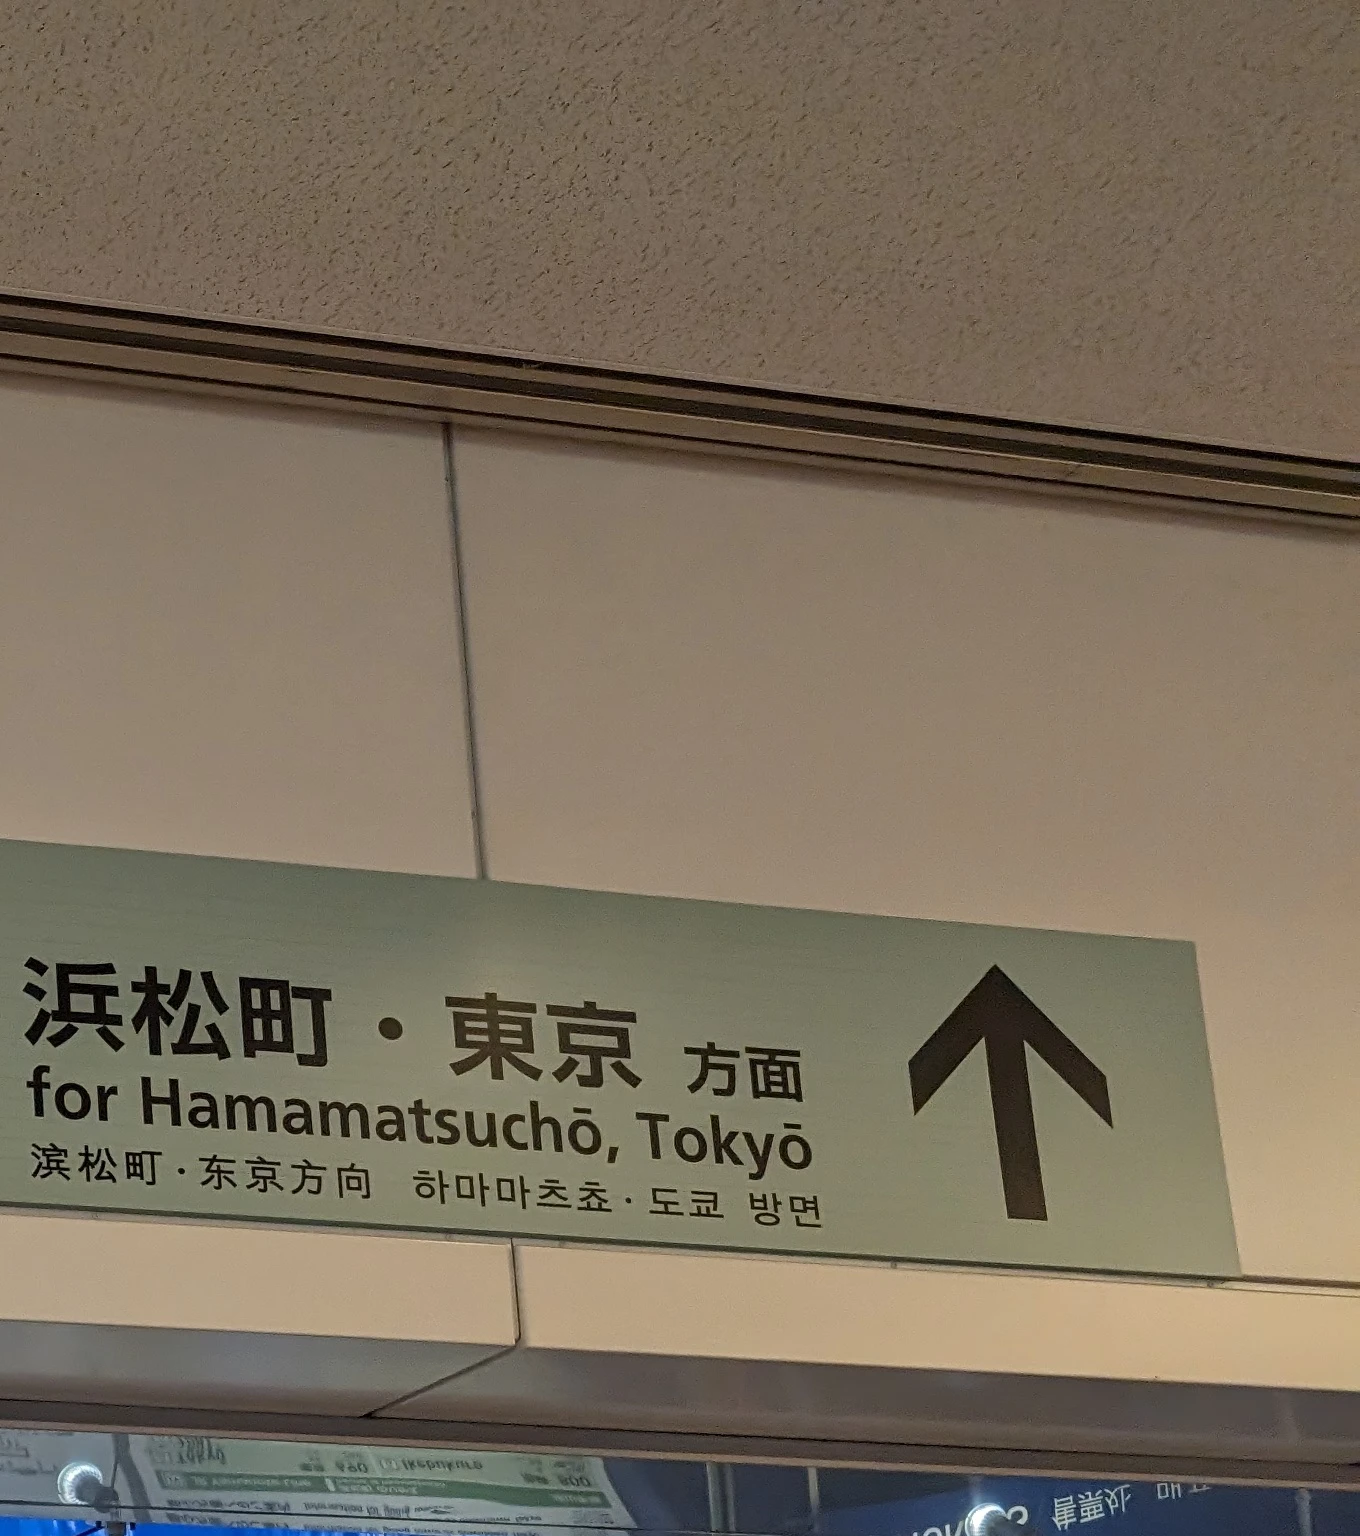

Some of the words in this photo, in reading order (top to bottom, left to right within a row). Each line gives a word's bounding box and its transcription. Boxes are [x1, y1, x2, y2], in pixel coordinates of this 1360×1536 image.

[23, 957, 643, 1090] 浜松町・東京
[684, 1042, 803, 1102] 方面
[27, 1065, 118, 1121] for
[140, 1072, 619, 1163] Hamamatsuchō,
[636, 1112, 812, 1180] Tokyō
[749, 1193, 821, 1228] 방면
